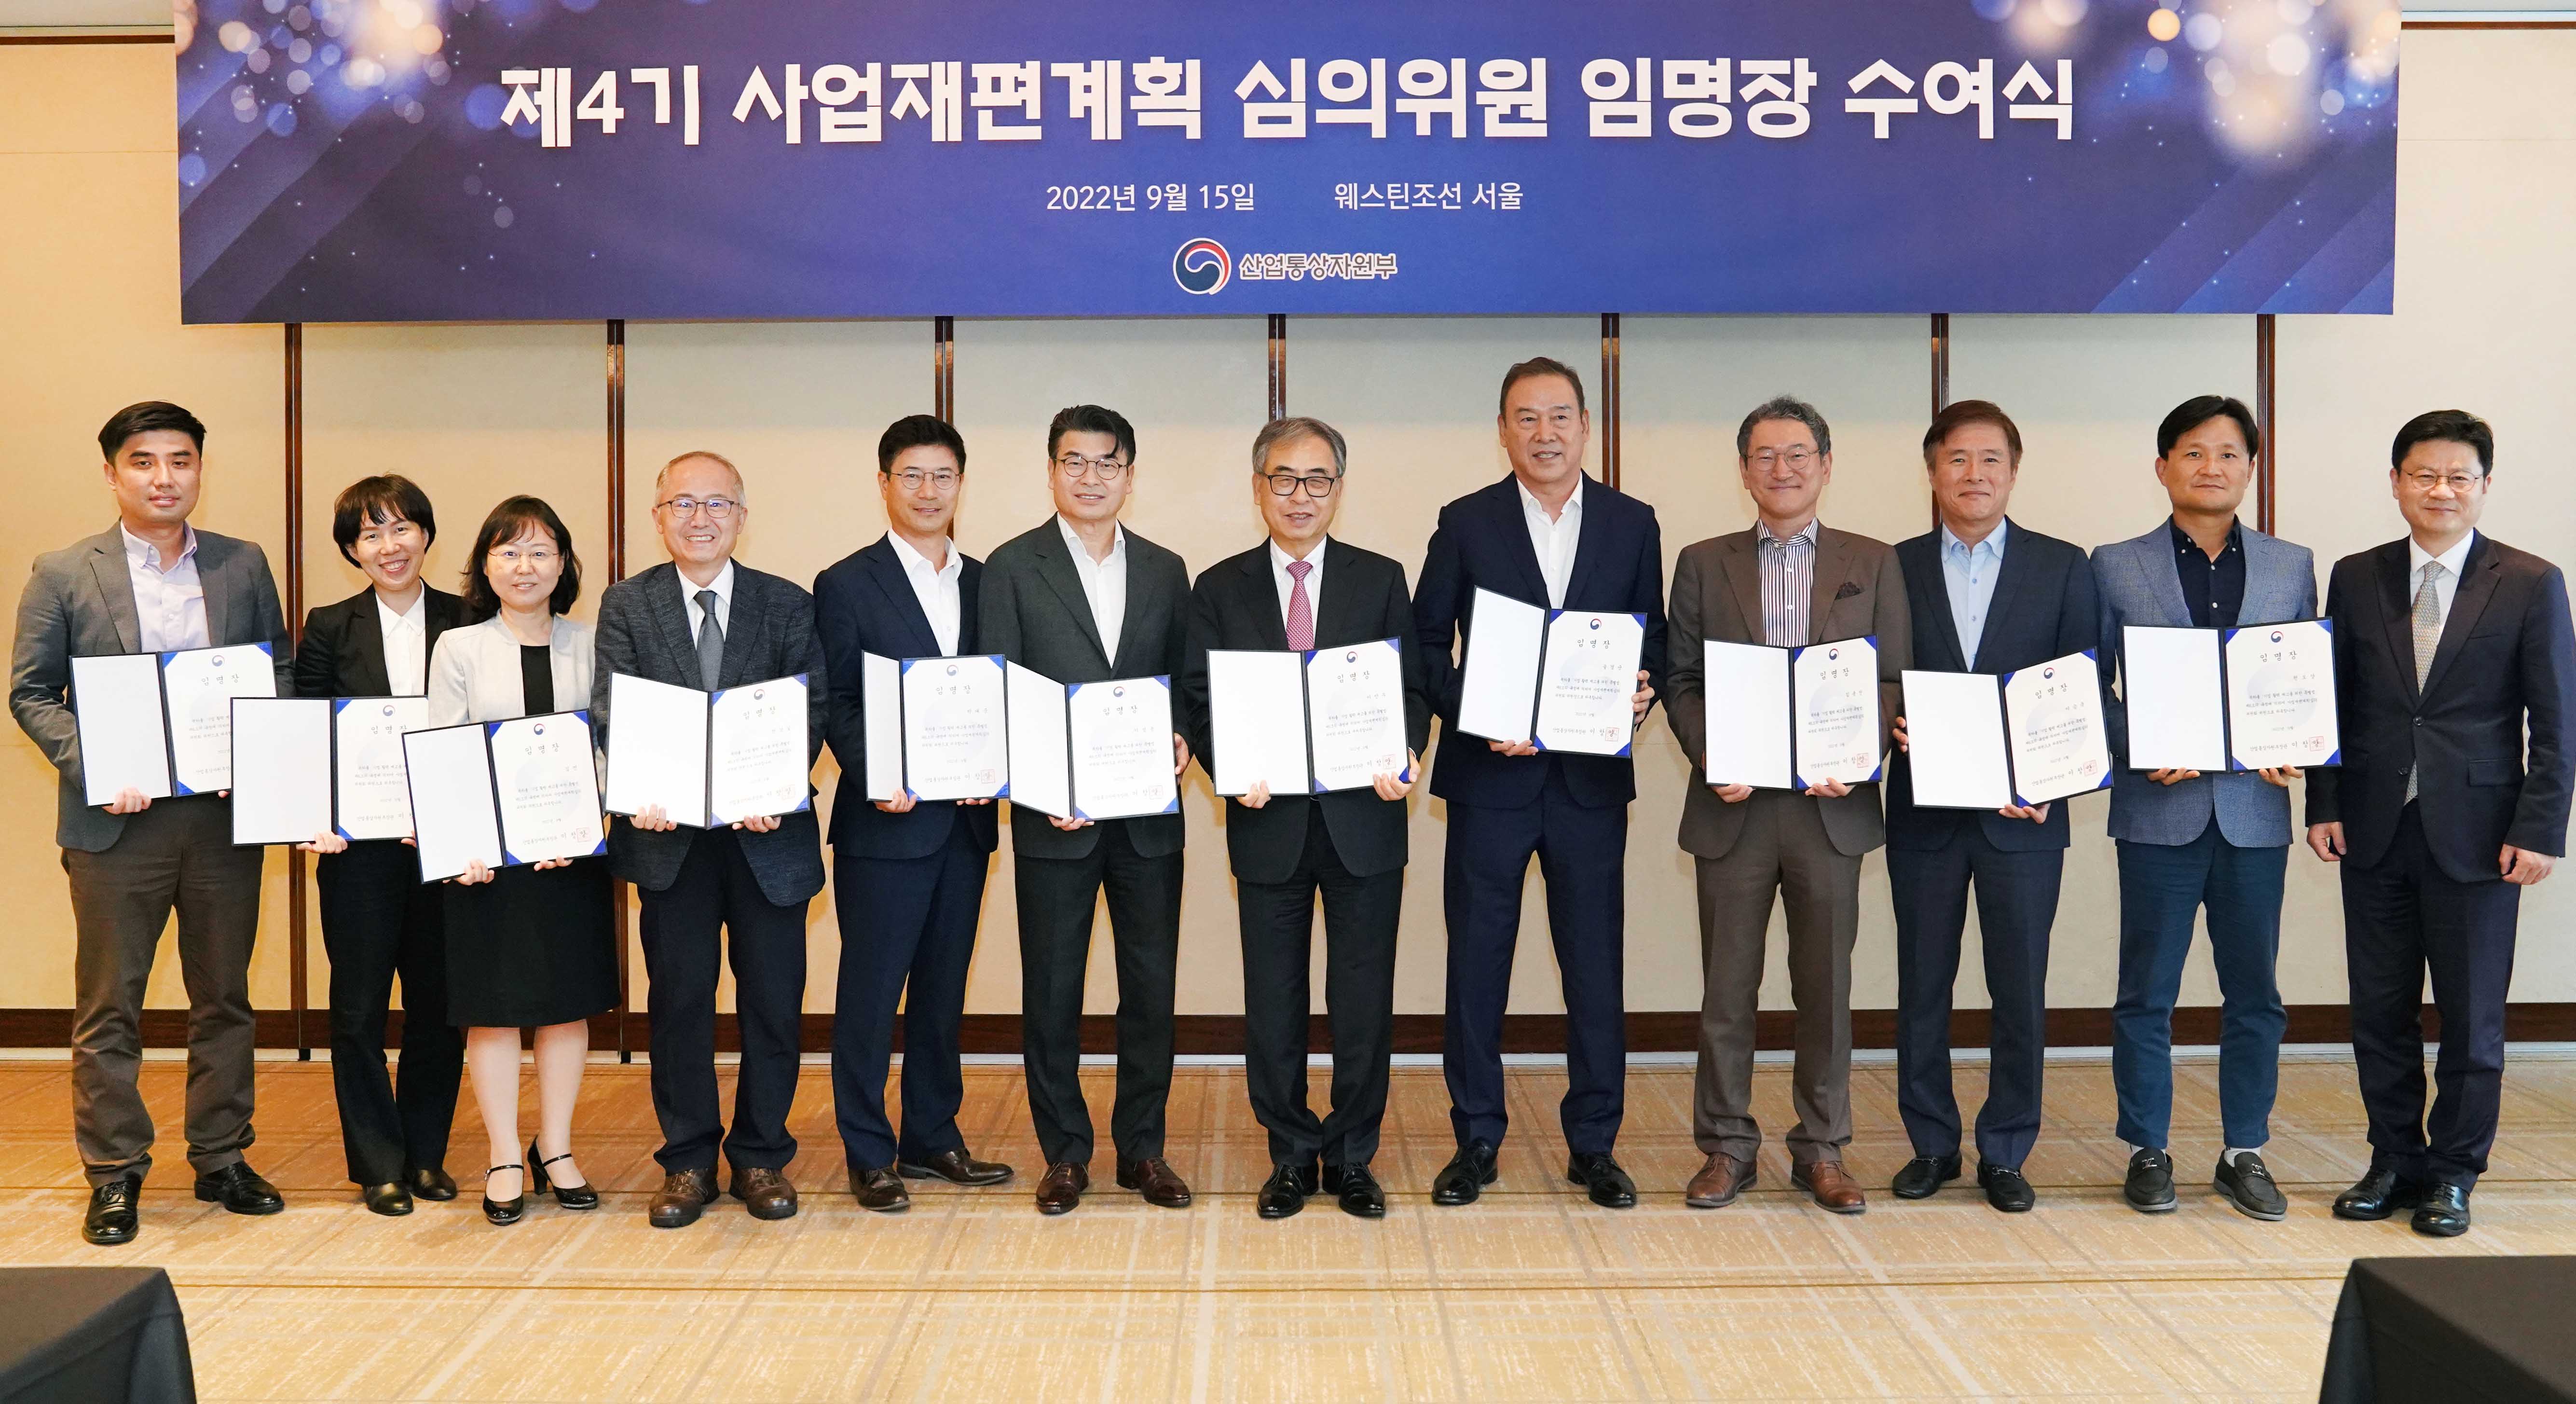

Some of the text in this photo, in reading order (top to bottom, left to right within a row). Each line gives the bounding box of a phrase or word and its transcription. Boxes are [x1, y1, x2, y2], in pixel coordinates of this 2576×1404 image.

[500, 56, 2073, 149] 제4기 사업재편계획 심의위원 임명장 수여식
[1046, 183, 1254, 212] 2022년 9월 15일
[1334, 182, 1524, 210] 웨스틴조선 서울
[1238, 252, 1398, 282] 산업통상자원부
